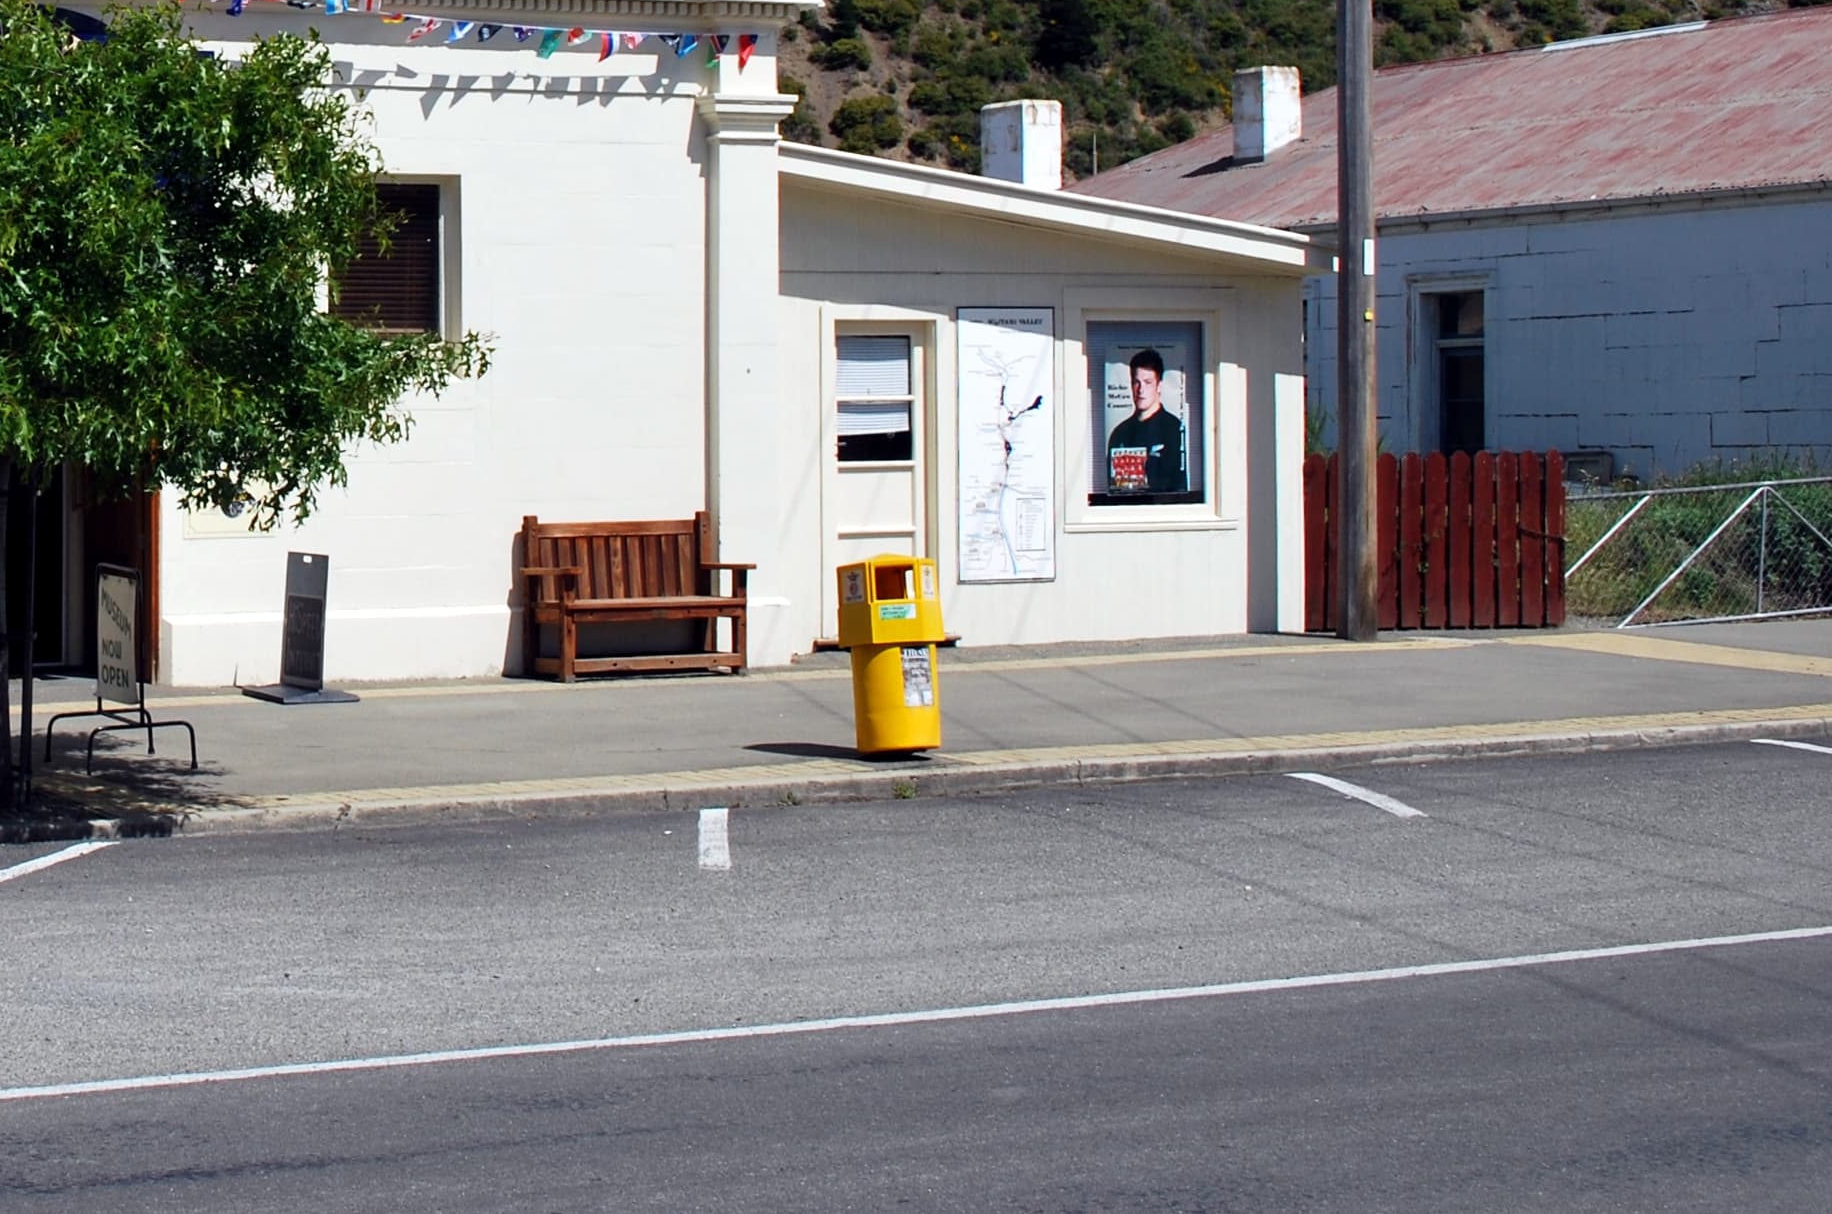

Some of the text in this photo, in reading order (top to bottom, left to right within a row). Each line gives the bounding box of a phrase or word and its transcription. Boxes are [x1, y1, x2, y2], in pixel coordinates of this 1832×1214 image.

[101, 588, 132, 642] MUSEUM
[101, 638, 123, 659] NOW
[101, 665, 130, 688] OPEN
